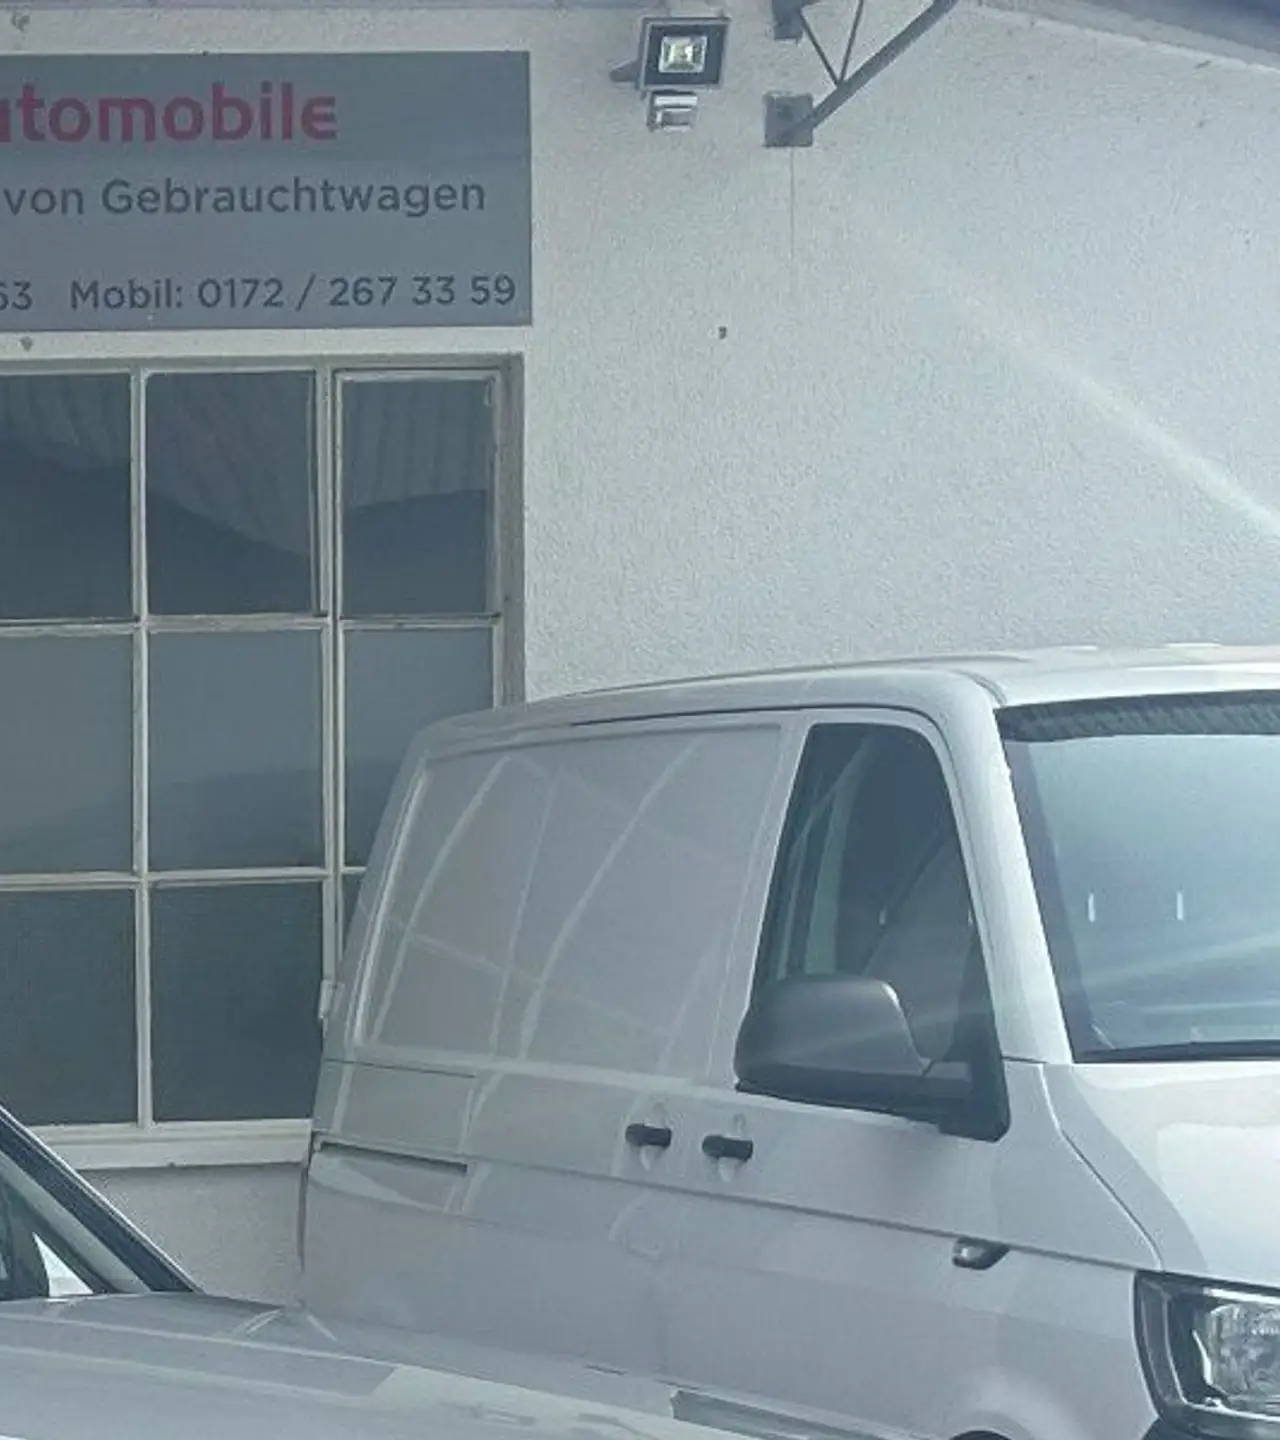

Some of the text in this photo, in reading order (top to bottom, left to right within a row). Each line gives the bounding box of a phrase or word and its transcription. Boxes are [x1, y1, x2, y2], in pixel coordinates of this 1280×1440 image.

[3, 186, 85, 216] von
[101, 176, 486, 218] Gebrauchtwagen
[70, 277, 183, 311] Mobil:
[197, 277, 285, 310] 0172
[294, 274, 317, 312] /
[328, 275, 399, 308] 267
[411, 275, 456, 307] 33
[469, 274, 517, 306] 59
